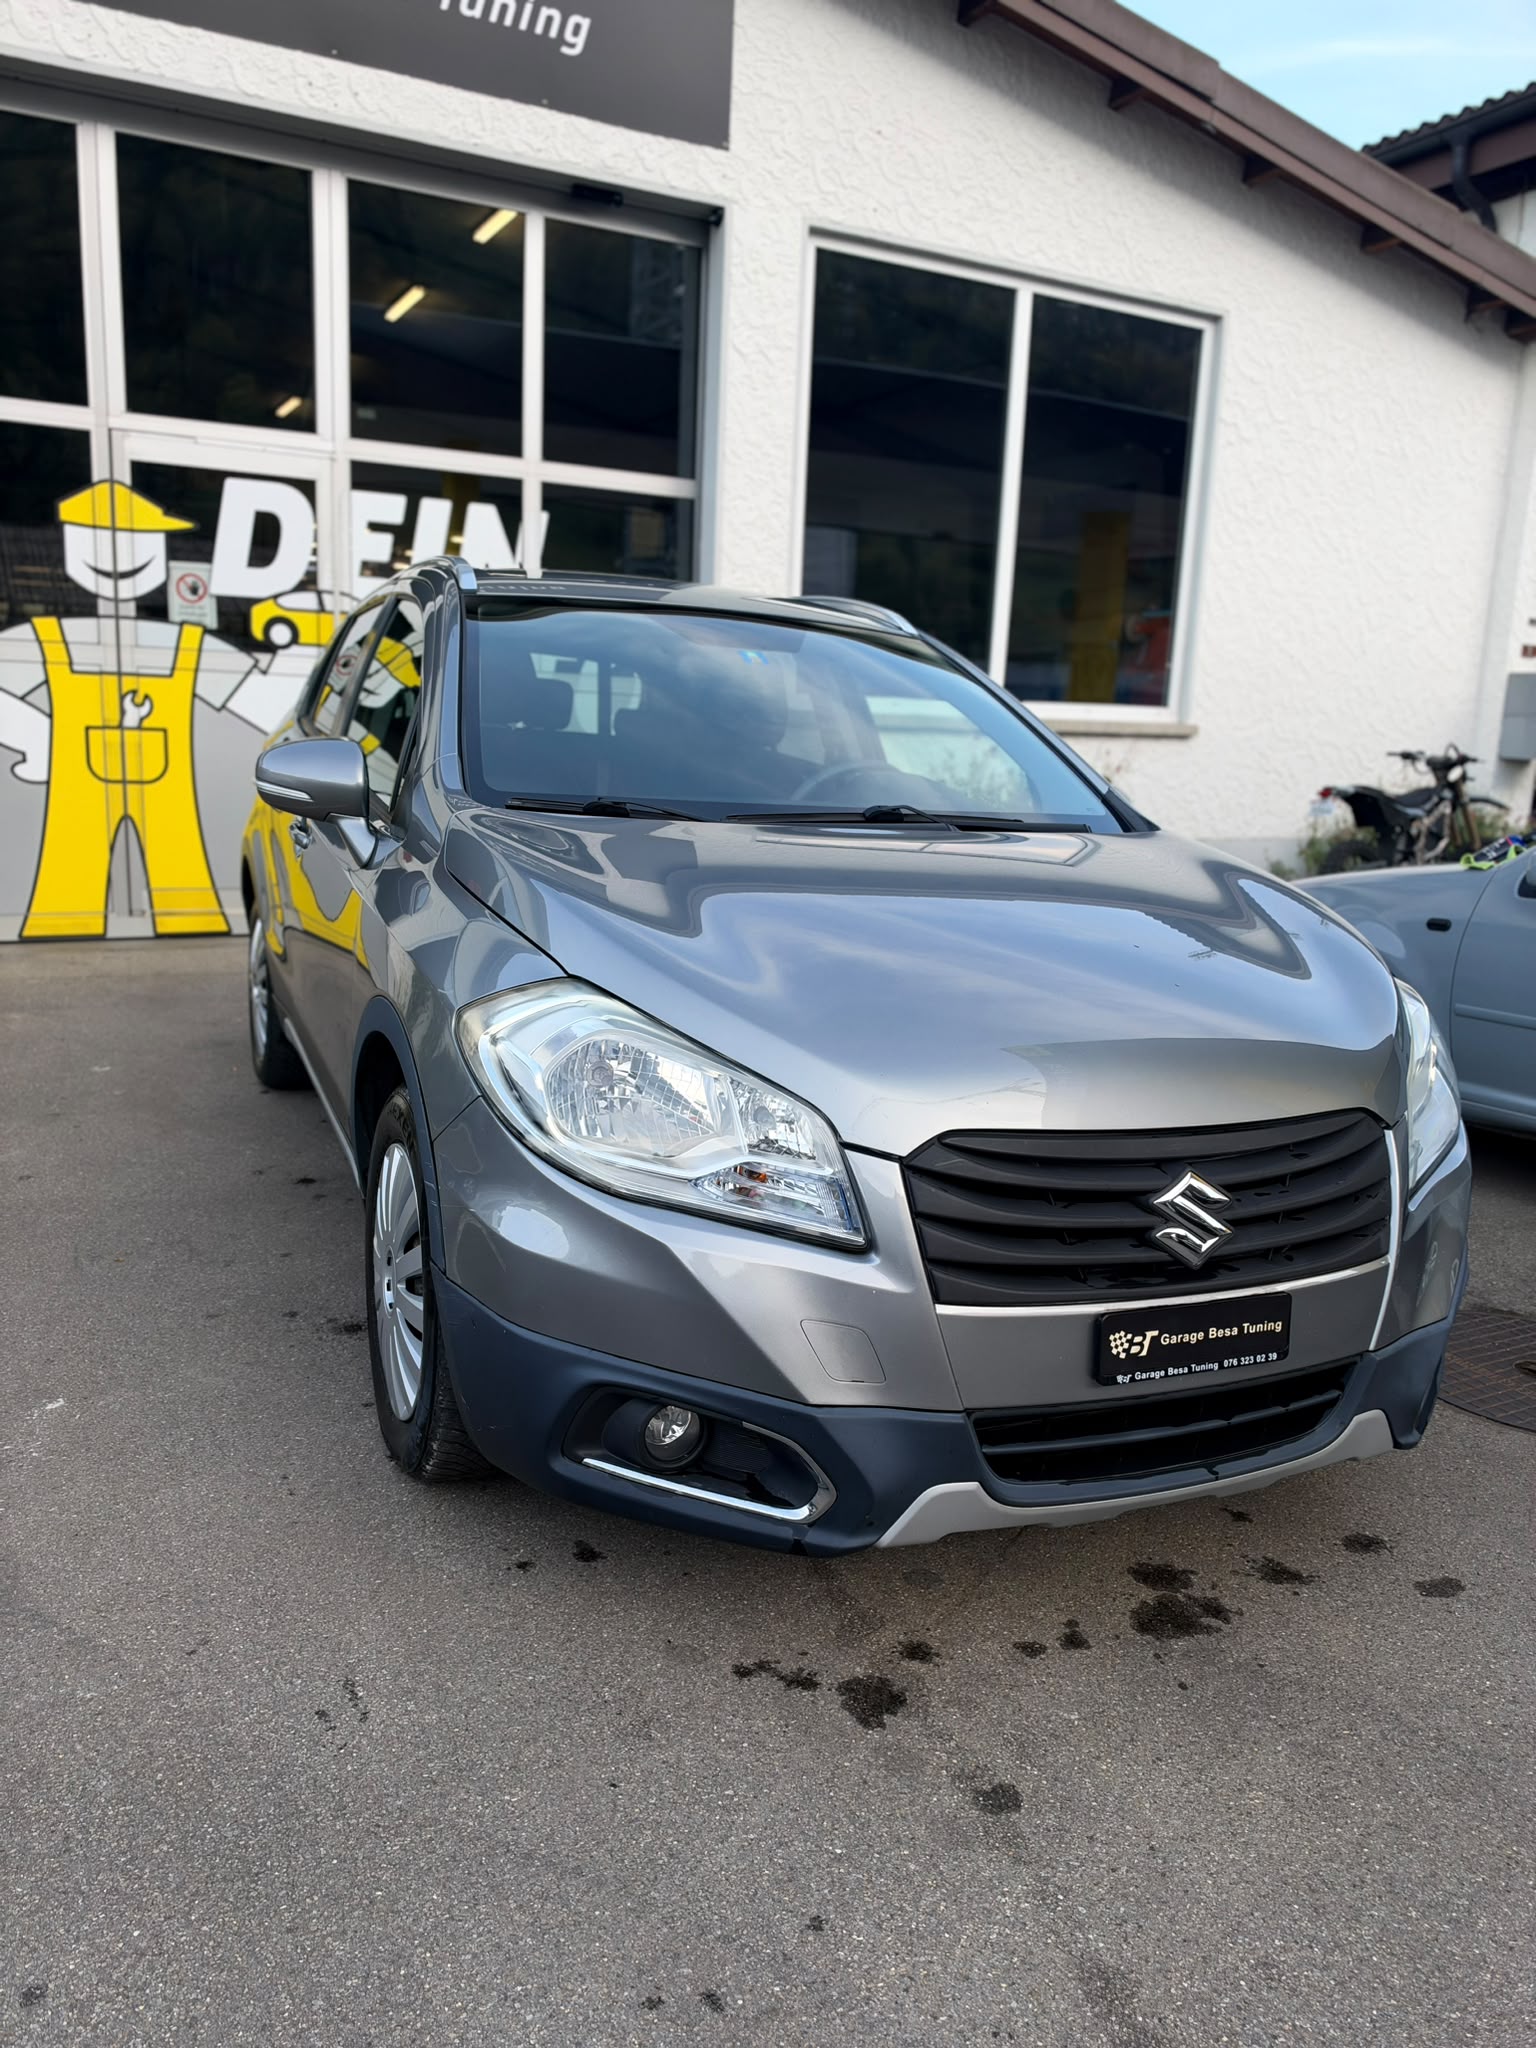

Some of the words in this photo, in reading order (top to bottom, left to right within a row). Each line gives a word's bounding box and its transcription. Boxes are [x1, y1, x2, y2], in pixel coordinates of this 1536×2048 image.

[439, 0, 592, 57] uning
[1160, 1331, 1205, 1346] Garage
[1208, 1326, 1239, 1339] Besa
[1242, 1320, 1283, 1335] Tuning
[1134, 1370, 1166, 1380] Garage
[1167, 1366, 1189, 1376] Besa
[1190, 1362, 1219, 1372] Tuning
[1223, 1358, 1238, 1368] 076
[1240, 1355, 1254, 1365] 323
[1256, 1354, 1266, 1363] 02
[1268, 1352, 1278, 1361] 39
